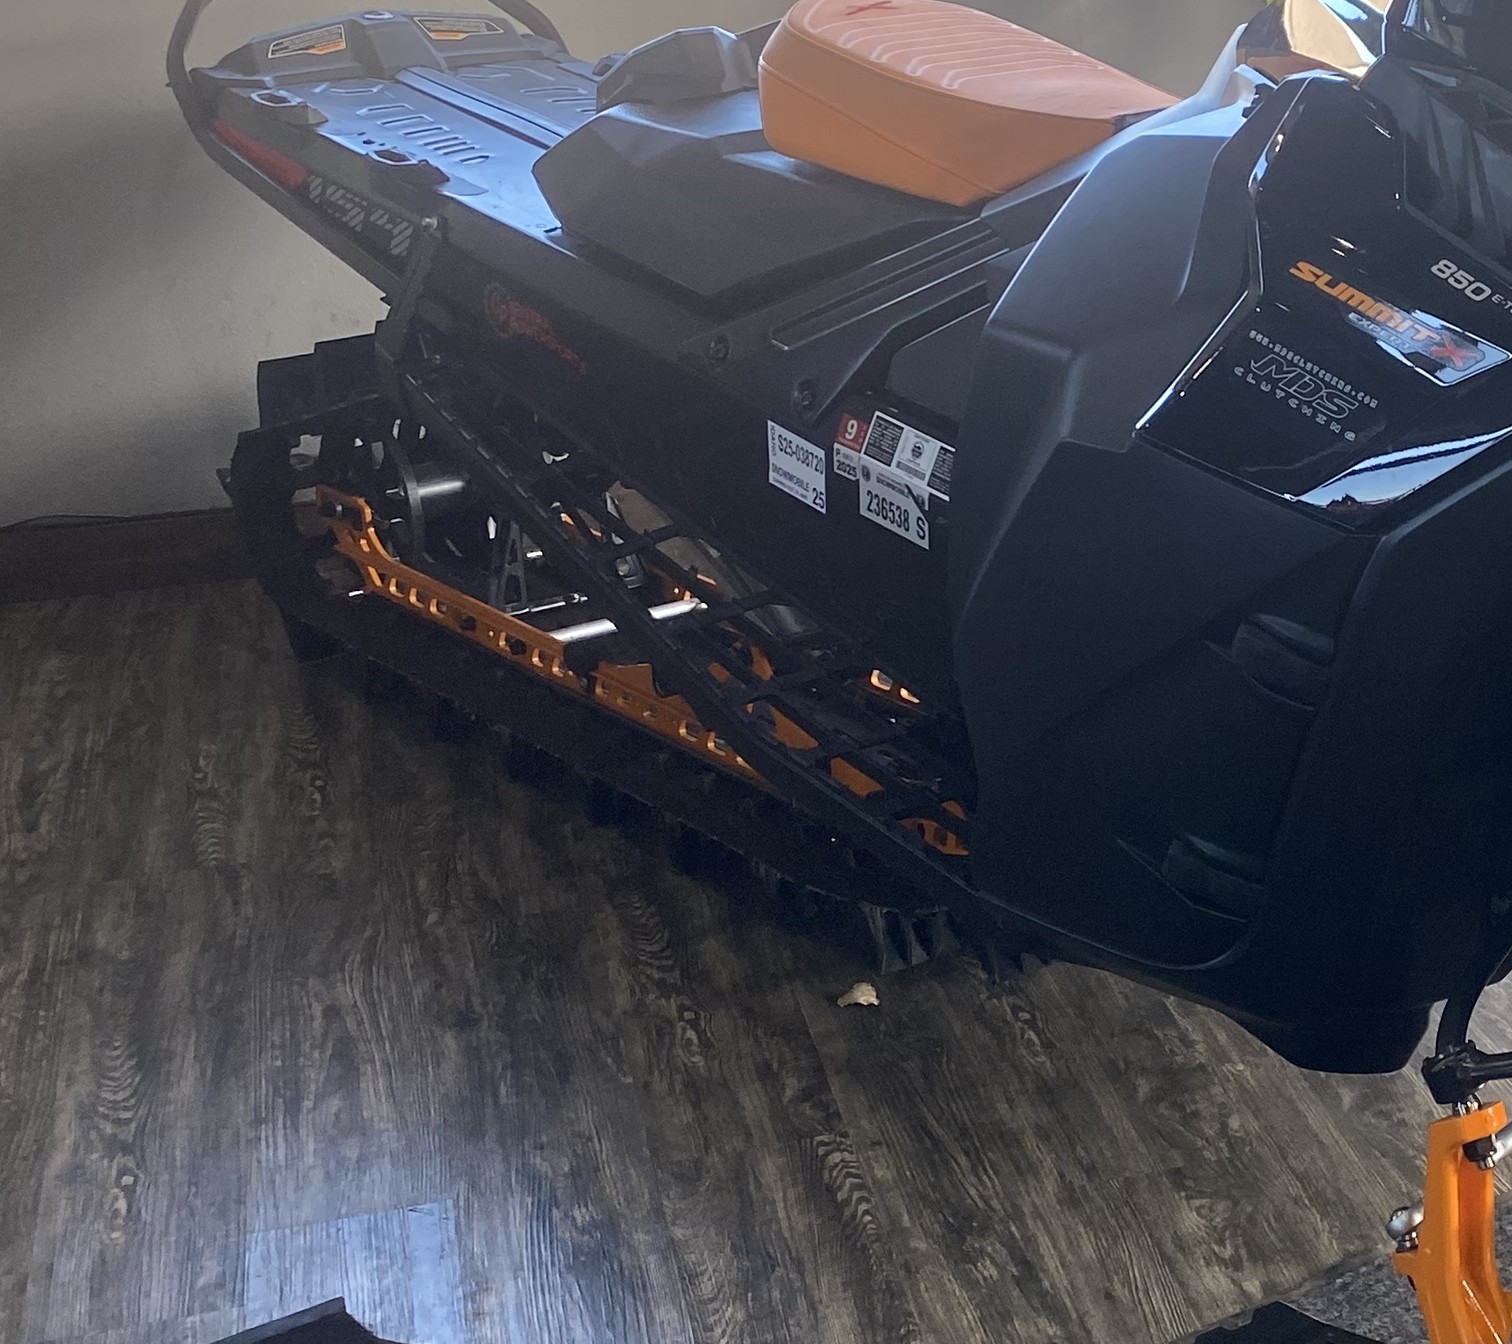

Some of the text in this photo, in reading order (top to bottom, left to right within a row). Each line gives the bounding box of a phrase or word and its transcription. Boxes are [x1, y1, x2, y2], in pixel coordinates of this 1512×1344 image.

[1289, 260, 1441, 343] SUMMIT
[1430, 259, 1492, 302] 850
[1233, 366, 1357, 442] CLUTCHING
[1250, 353, 1359, 419] MDS
[845, 419, 858, 440] 9
[836, 460, 858, 478] 2025
[812, 487, 825, 509] 25
[866, 490, 926, 541] 236538 S
